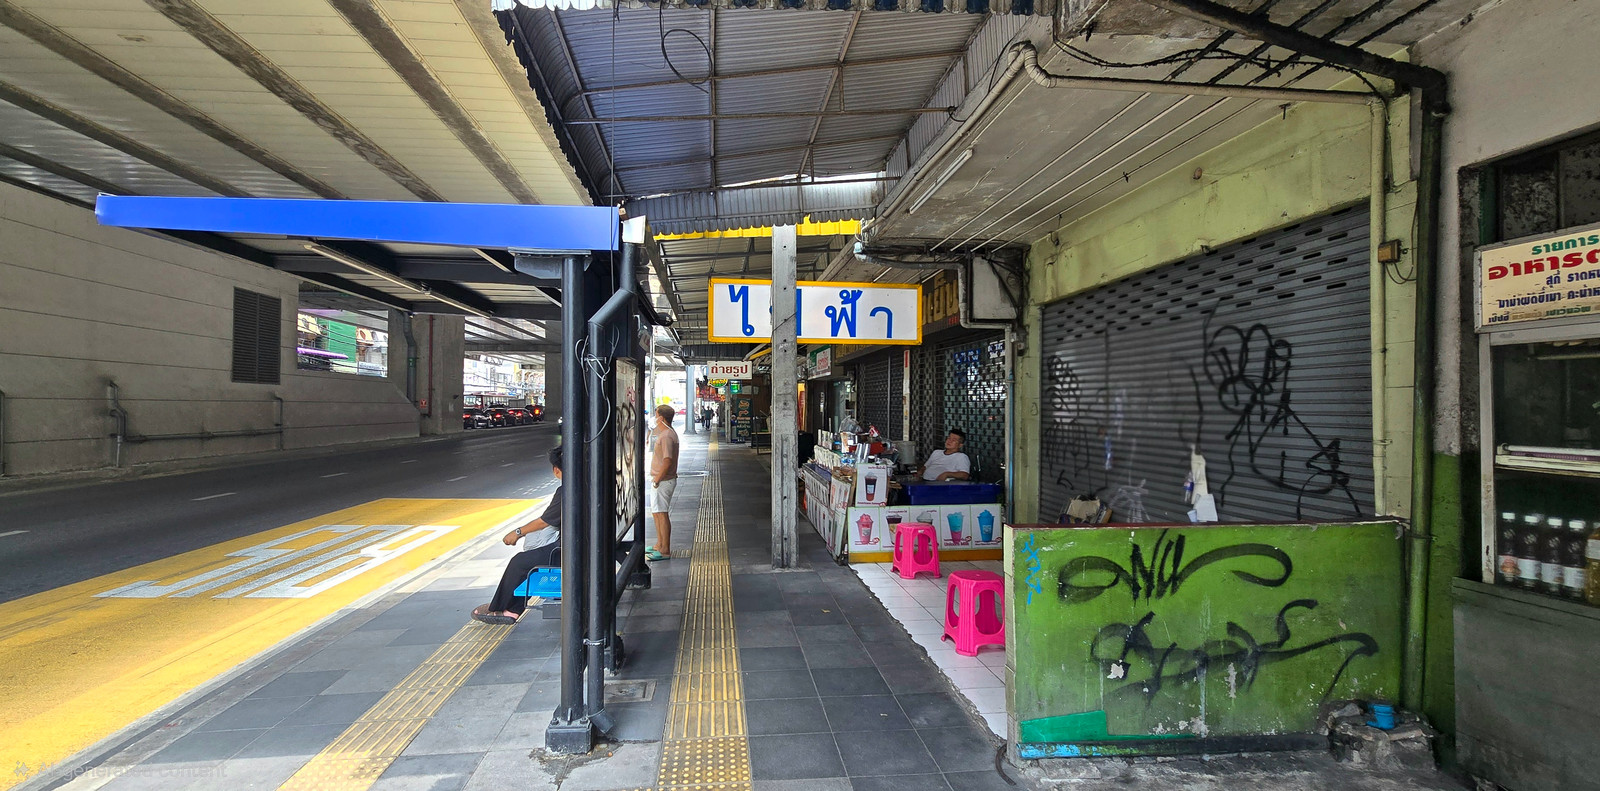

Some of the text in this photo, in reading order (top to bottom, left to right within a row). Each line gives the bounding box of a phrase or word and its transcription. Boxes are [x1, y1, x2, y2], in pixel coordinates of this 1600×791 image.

[1531, 234, 1600, 255] รายการ
[728, 284, 893, 339] ไฟ้า
[710, 362, 748, 377] ถ่ายรูป
